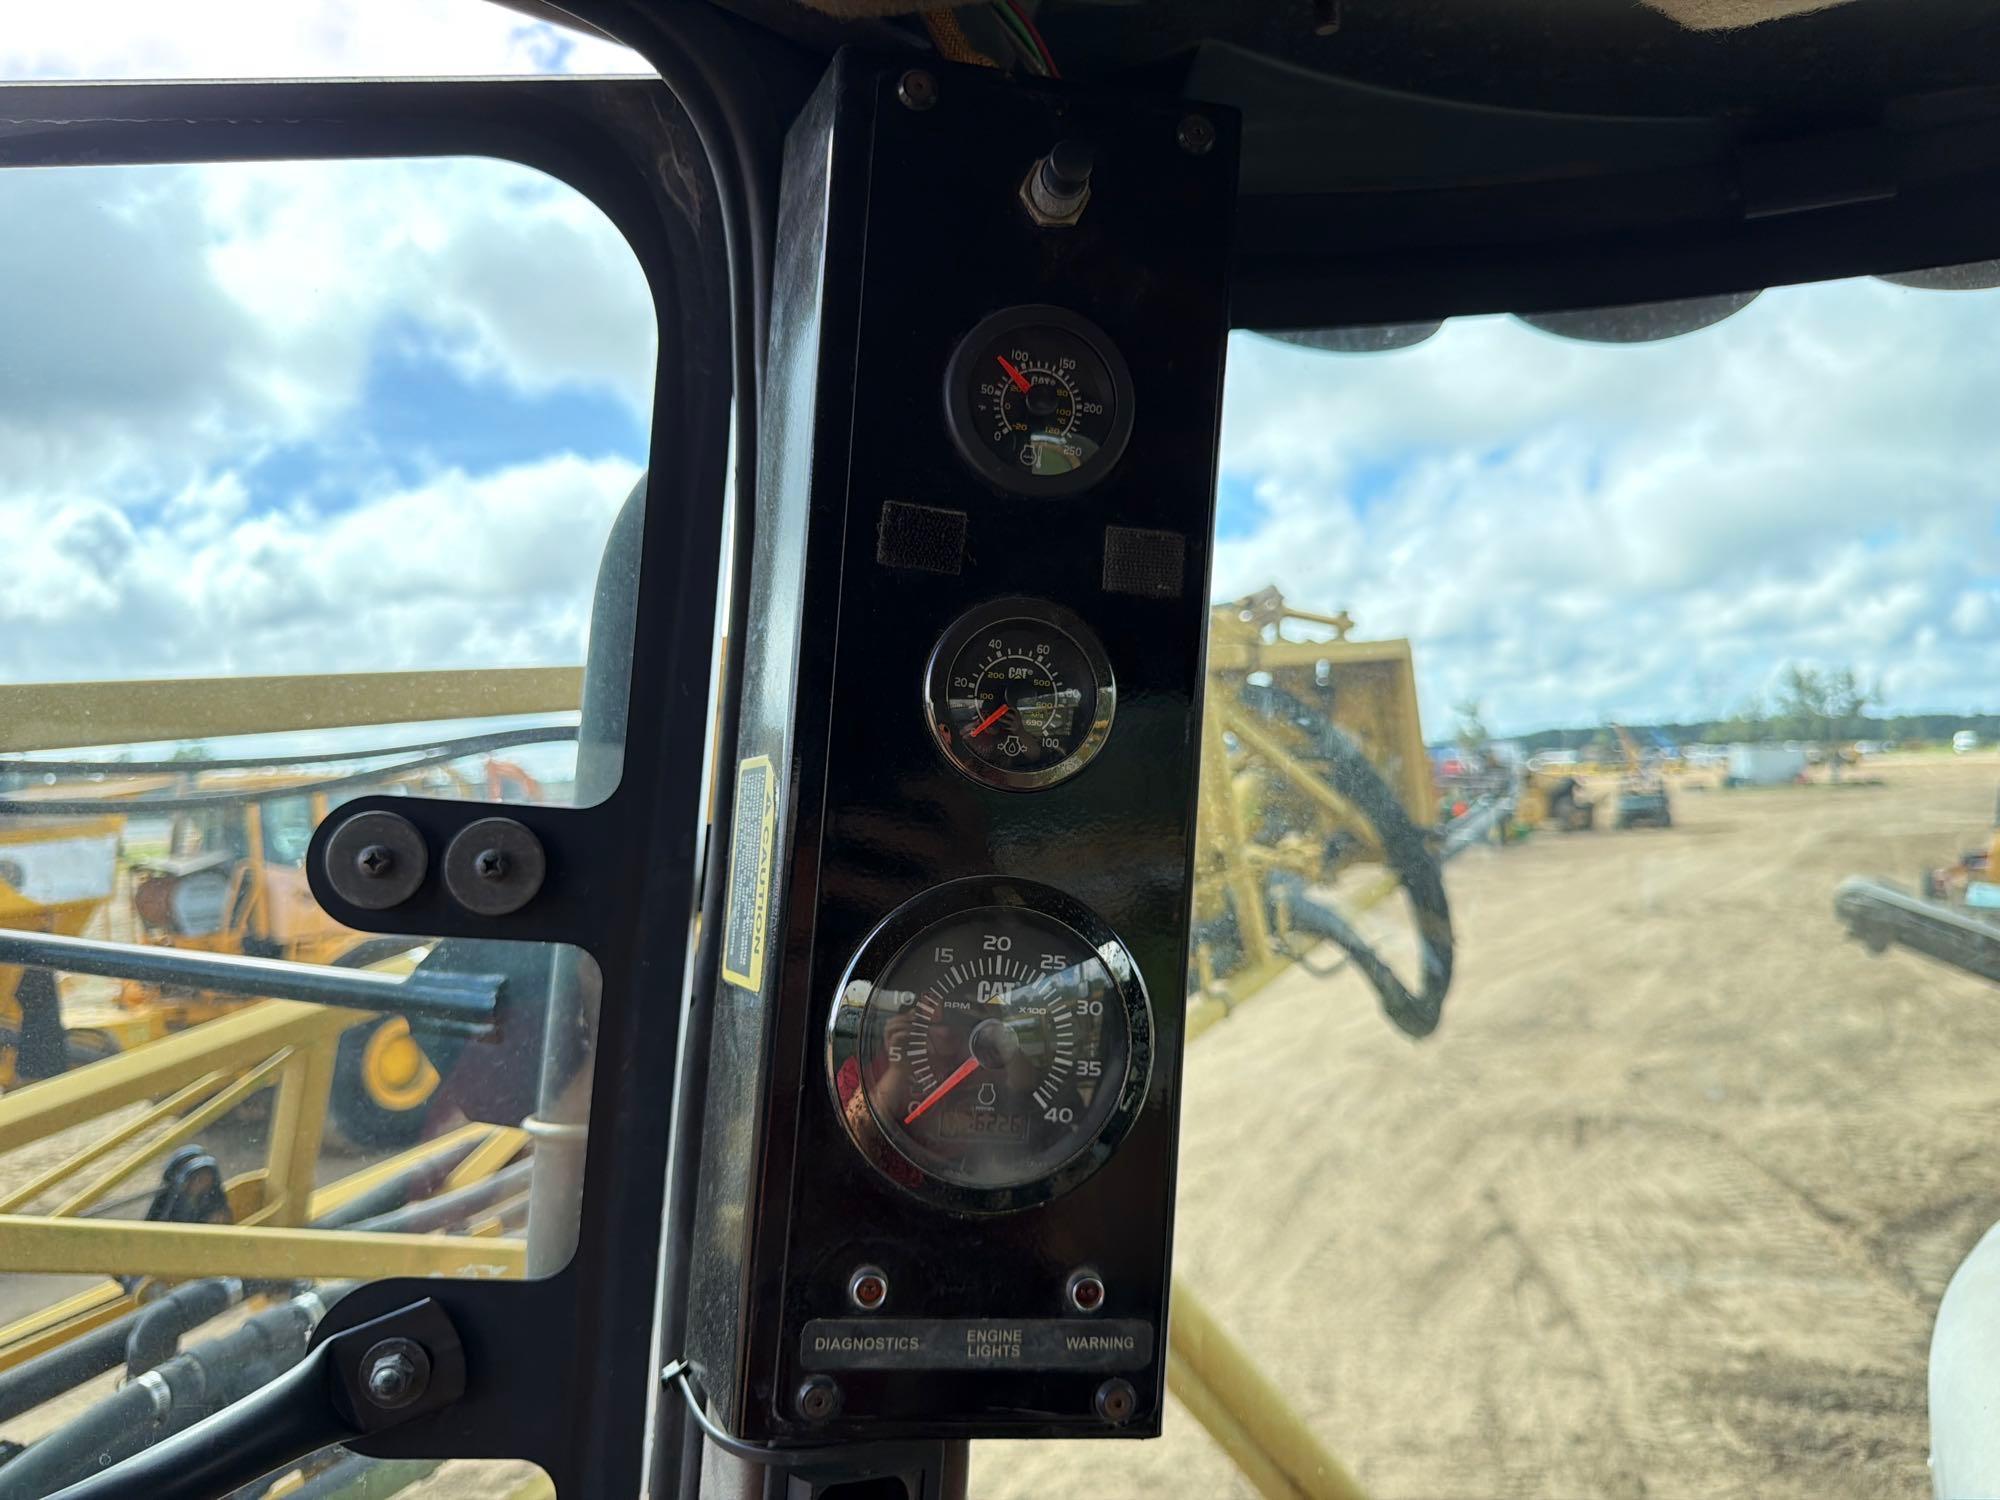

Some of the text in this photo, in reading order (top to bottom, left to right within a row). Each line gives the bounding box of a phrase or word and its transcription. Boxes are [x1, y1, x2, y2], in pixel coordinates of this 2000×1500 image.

[1011, 349, 1029, 362] 100
[1059, 357, 1076, 370] 150
[981, 384, 994, 396] 50
[1056, 409, 1071, 417] 100
[1083, 403, 1103, 415] 200
[994, 432, 1001, 441] 0
[988, 639, 1002, 650] 40
[1036, 644, 1050, 655] 60
[954, 677, 967, 687] 20
[987, 671, 1005, 680] 200
[1033, 679, 1051, 687] 500
[980, 692, 994, 700] 100
[1042, 738, 1059, 748] 100
[754, 826, 770, 954] CAUTION
[983, 935, 1011, 951] 20
[934, 947, 954, 963] 15
[1040, 954, 1067, 969] 25
[894, 991, 915, 1005] 10
[944, 1001, 971, 1010] RPM
[1076, 1000, 1104, 1015] 30
[888, 1047, 901, 1062] 5
[1076, 1061, 1101, 1076] 35
[1044, 1108, 1073, 1123] 40
[966, 1329, 1022, 1344] ENGINE
[1066, 1336, 1134, 1350] WARNING
[815, 1336, 920, 1351] DIAGNOSTICS
[967, 1344, 1021, 1358] LIGHTS
